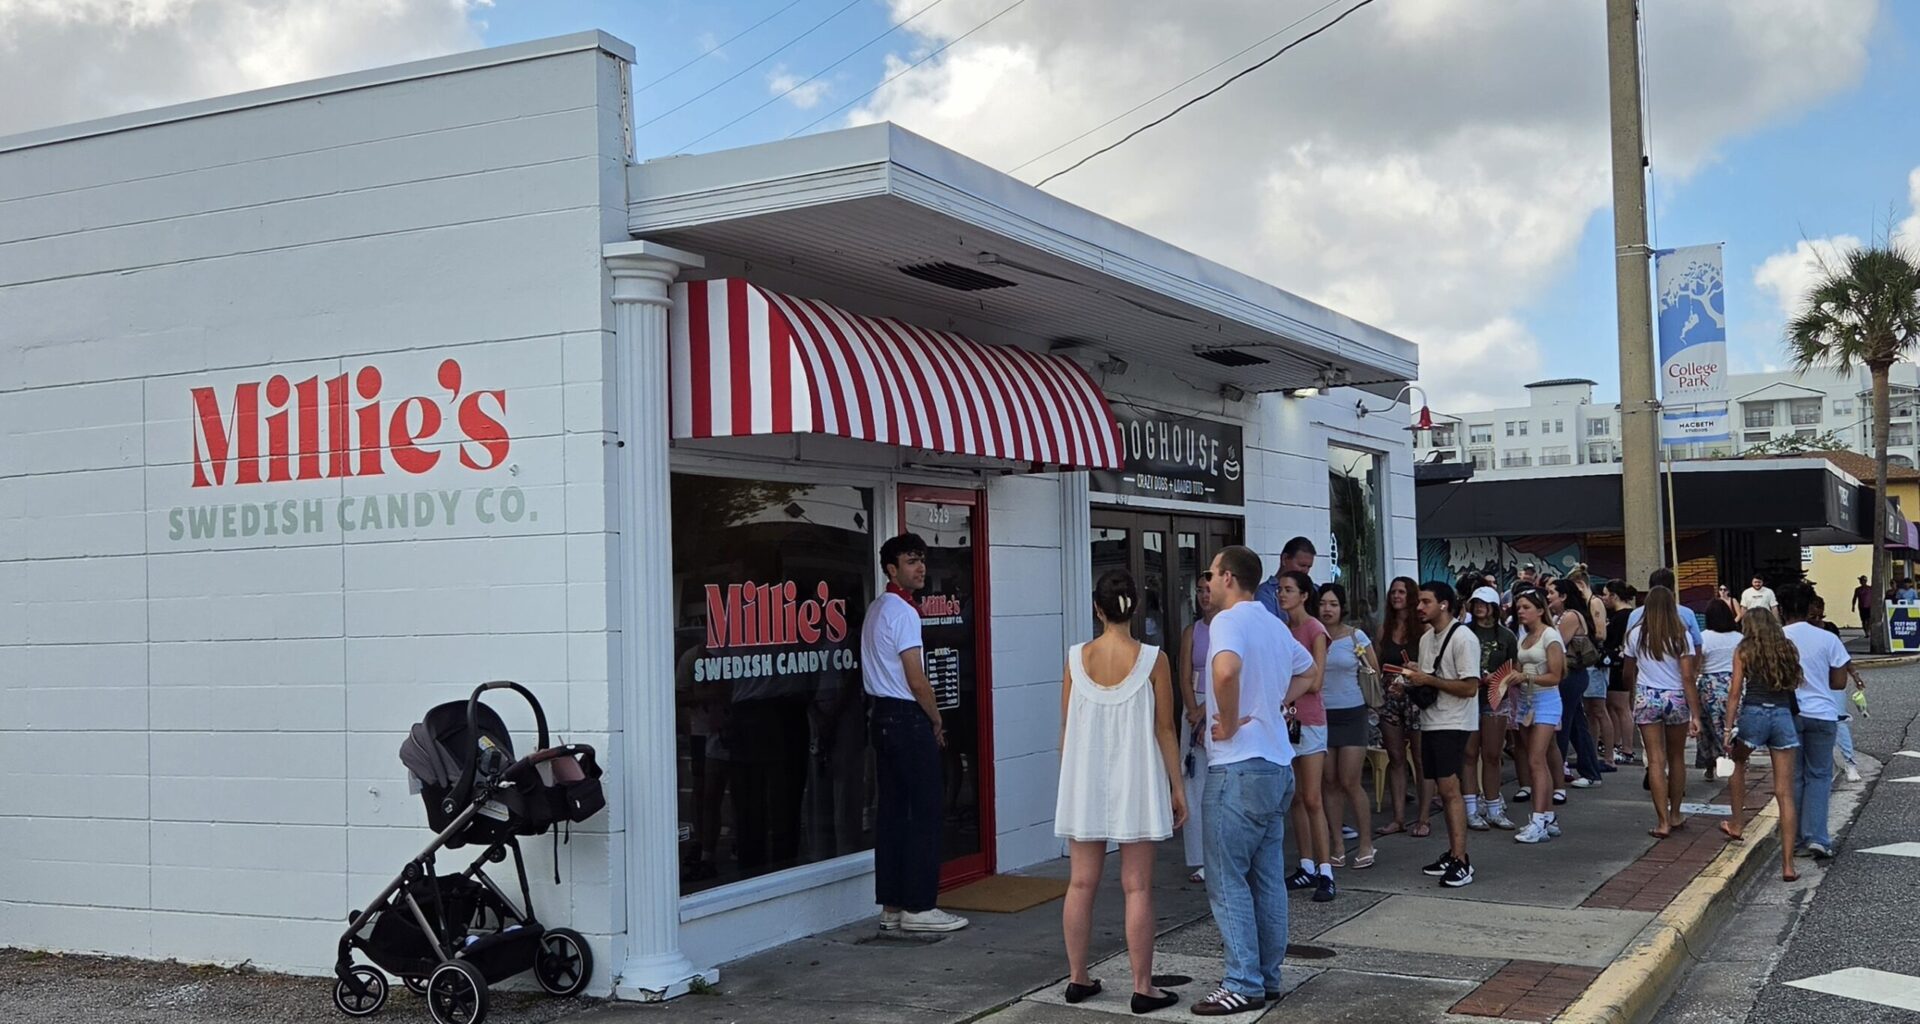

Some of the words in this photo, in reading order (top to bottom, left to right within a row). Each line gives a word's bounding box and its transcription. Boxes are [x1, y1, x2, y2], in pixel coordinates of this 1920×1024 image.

[1669, 362, 1718, 377] College
[1679, 374, 1709, 388] Park
[190, 358, 510, 488] Millie's
[1137, 473, 1153, 489] CRAZY
[1154, 475, 1168, 491] DOGS
[1174, 478, 1192, 494] LOADED
[1192, 480, 1204, 496] TOTS
[168, 499, 324, 541] SWEDISH
[337, 490, 461, 533] CANDY
[475, 486, 538, 522] CO.
[929, 508, 949, 523] 2529
[704, 580, 847, 648] Millie's
[694, 654, 773, 682] SWEDISH
[776, 650, 829, 675] CANDY
[833, 648, 858, 670] CO.
